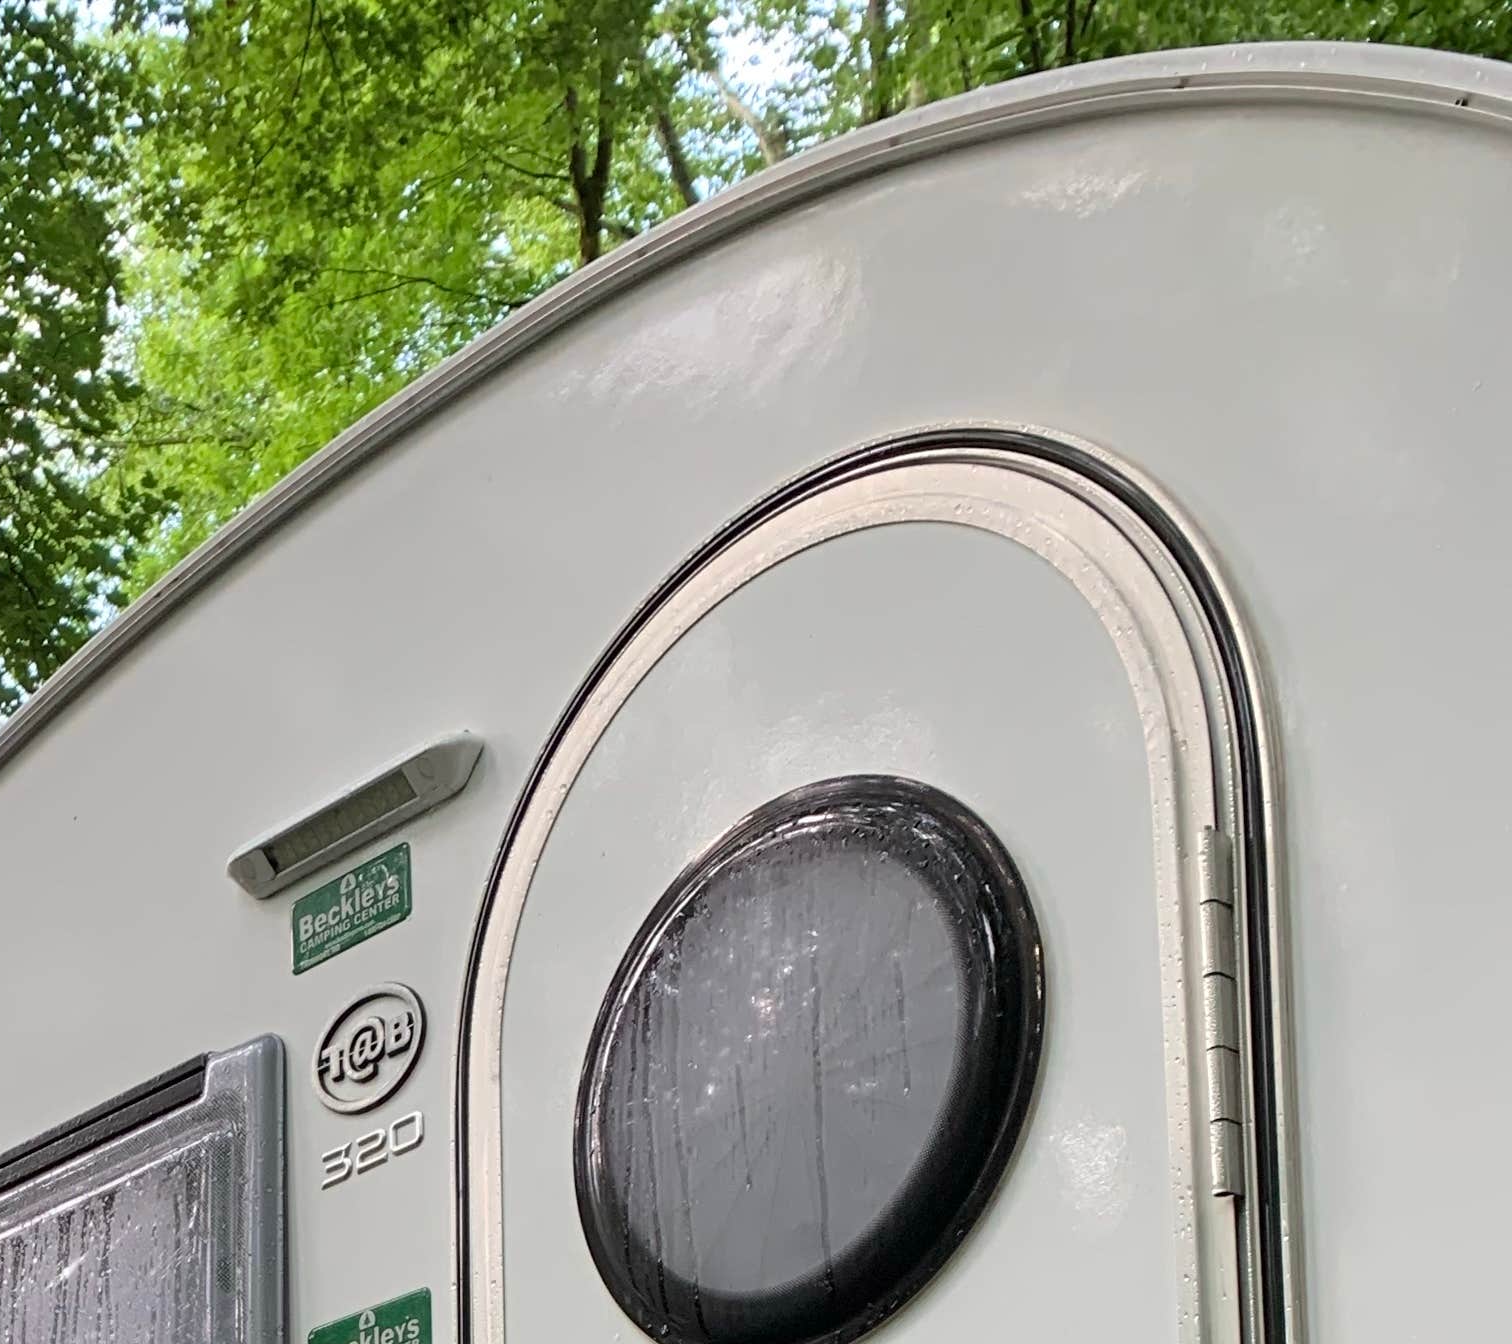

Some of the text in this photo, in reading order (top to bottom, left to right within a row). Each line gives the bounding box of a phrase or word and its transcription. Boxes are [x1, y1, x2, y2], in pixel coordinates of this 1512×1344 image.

[300, 919, 351, 954] CAMPING
[354, 893, 400, 925] CENTER
[321, 1111, 424, 1190] 320
